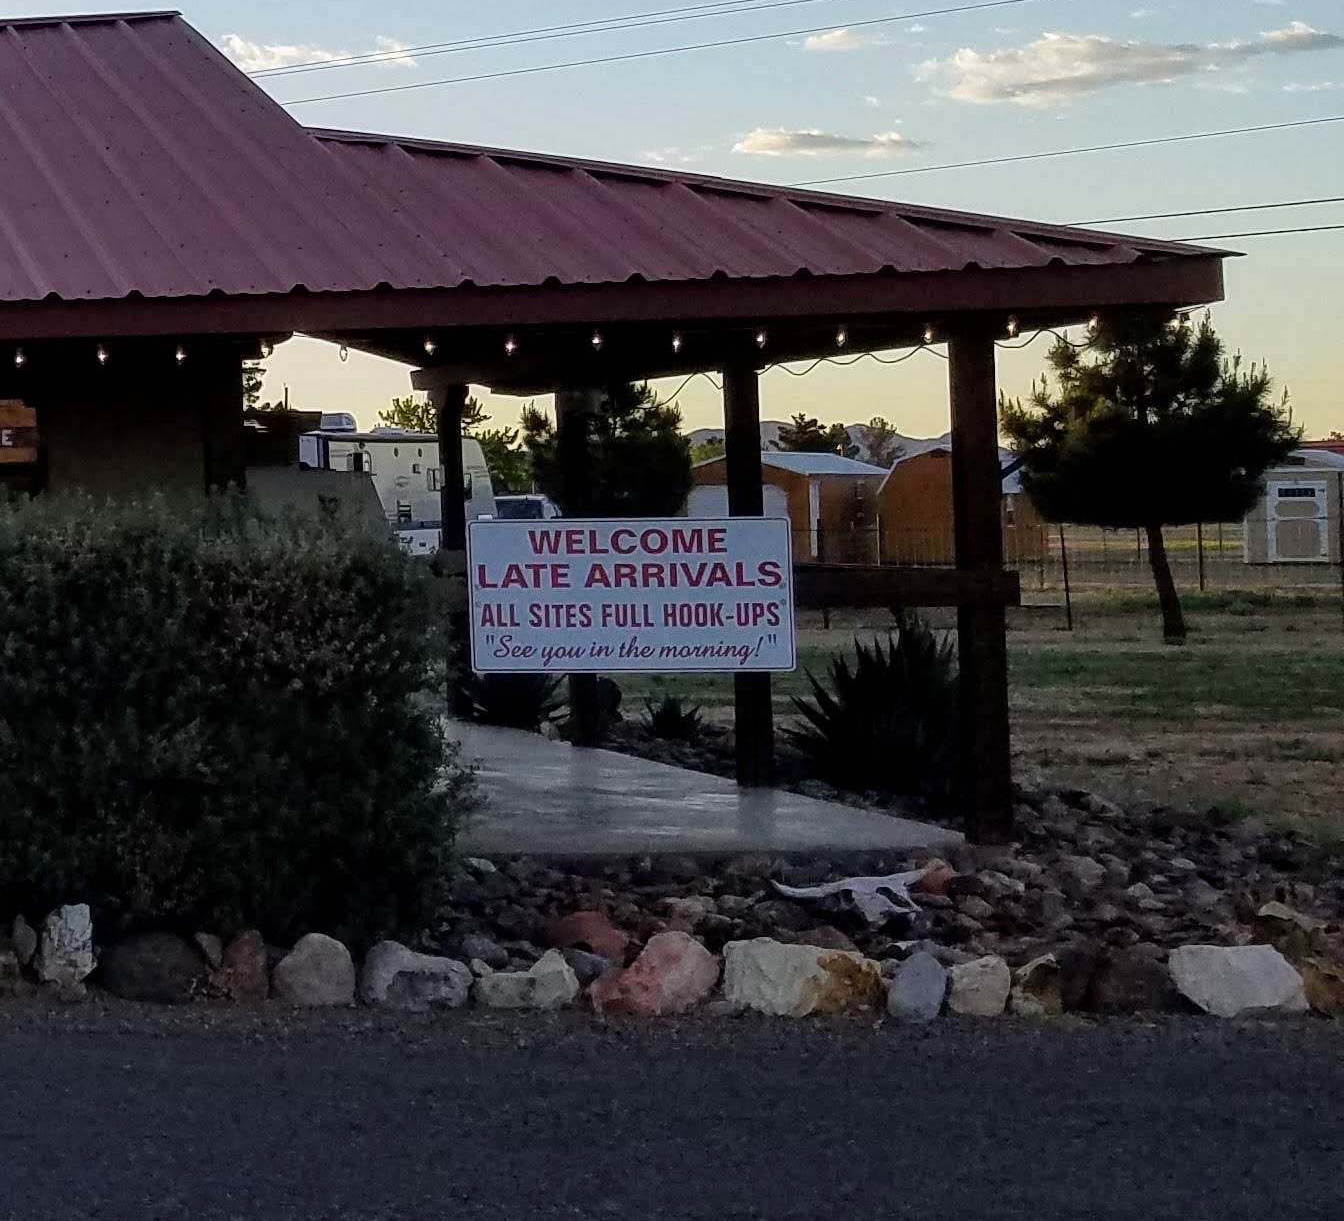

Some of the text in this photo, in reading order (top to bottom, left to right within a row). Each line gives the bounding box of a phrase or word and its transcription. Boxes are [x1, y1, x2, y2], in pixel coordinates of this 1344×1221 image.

[527, 528, 728, 555] WELCOME
[478, 561, 783, 589] LATE ARRIVALS
[480, 601, 781, 628] ALL SITES FULL HOOK-UPS
[485, 633, 777, 667] "See you in the morning!"
